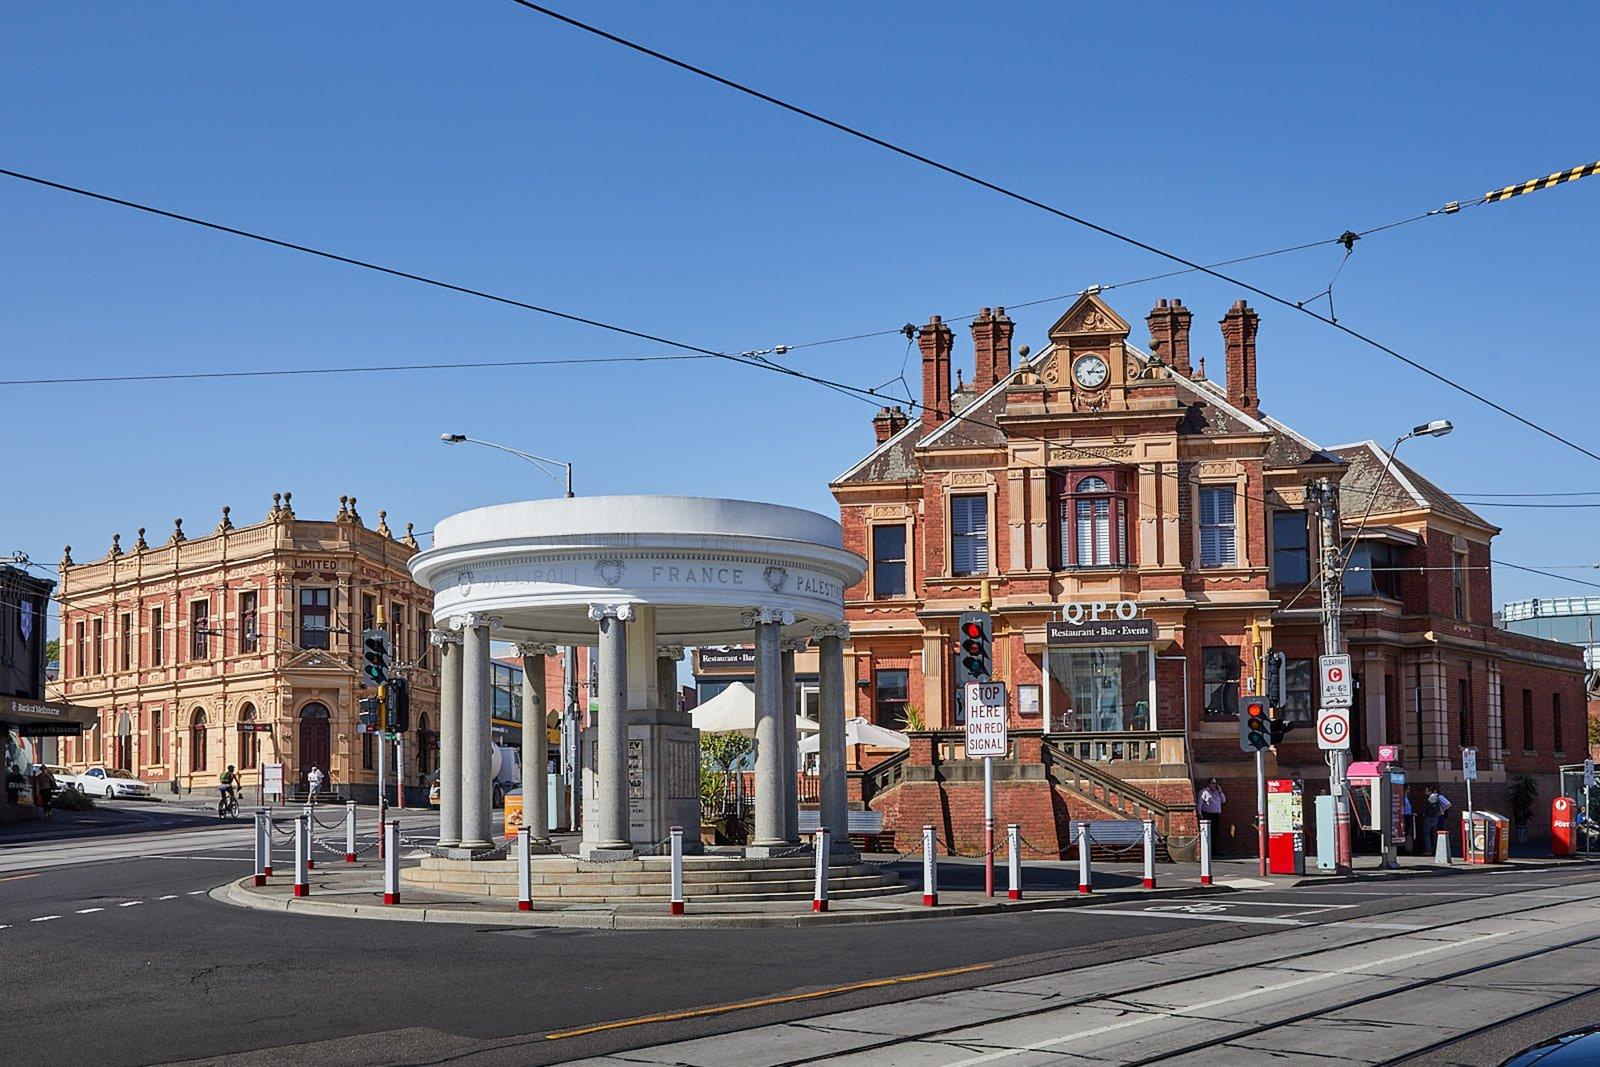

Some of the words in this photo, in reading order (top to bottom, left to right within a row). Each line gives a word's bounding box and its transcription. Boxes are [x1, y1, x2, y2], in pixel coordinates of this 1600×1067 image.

[294, 560, 337, 570] LIMITED
[651, 566, 744, 585] FRANCE
[1062, 600, 1137, 626] QPO
[1051, 628, 1095, 638] Restaurant
[1100, 627, 1117, 636] Bar
[1122, 626, 1149, 635] Events
[702, 654, 738, 662] Restaurant
[742, 653, 756, 661] Bar
[1323, 659, 1347, 667] CLEARWAY
[972, 686, 1000, 701] STOP
[18, 703, 31, 712] Bank
[36, 704, 60, 716] Melbourne
[971, 705, 1000, 718] HERE
[969, 723, 982, 734] ON
[984, 722, 1003, 733] RED
[1324, 722, 1343, 735] 60
[969, 738, 1003, 750] SIGNAL
